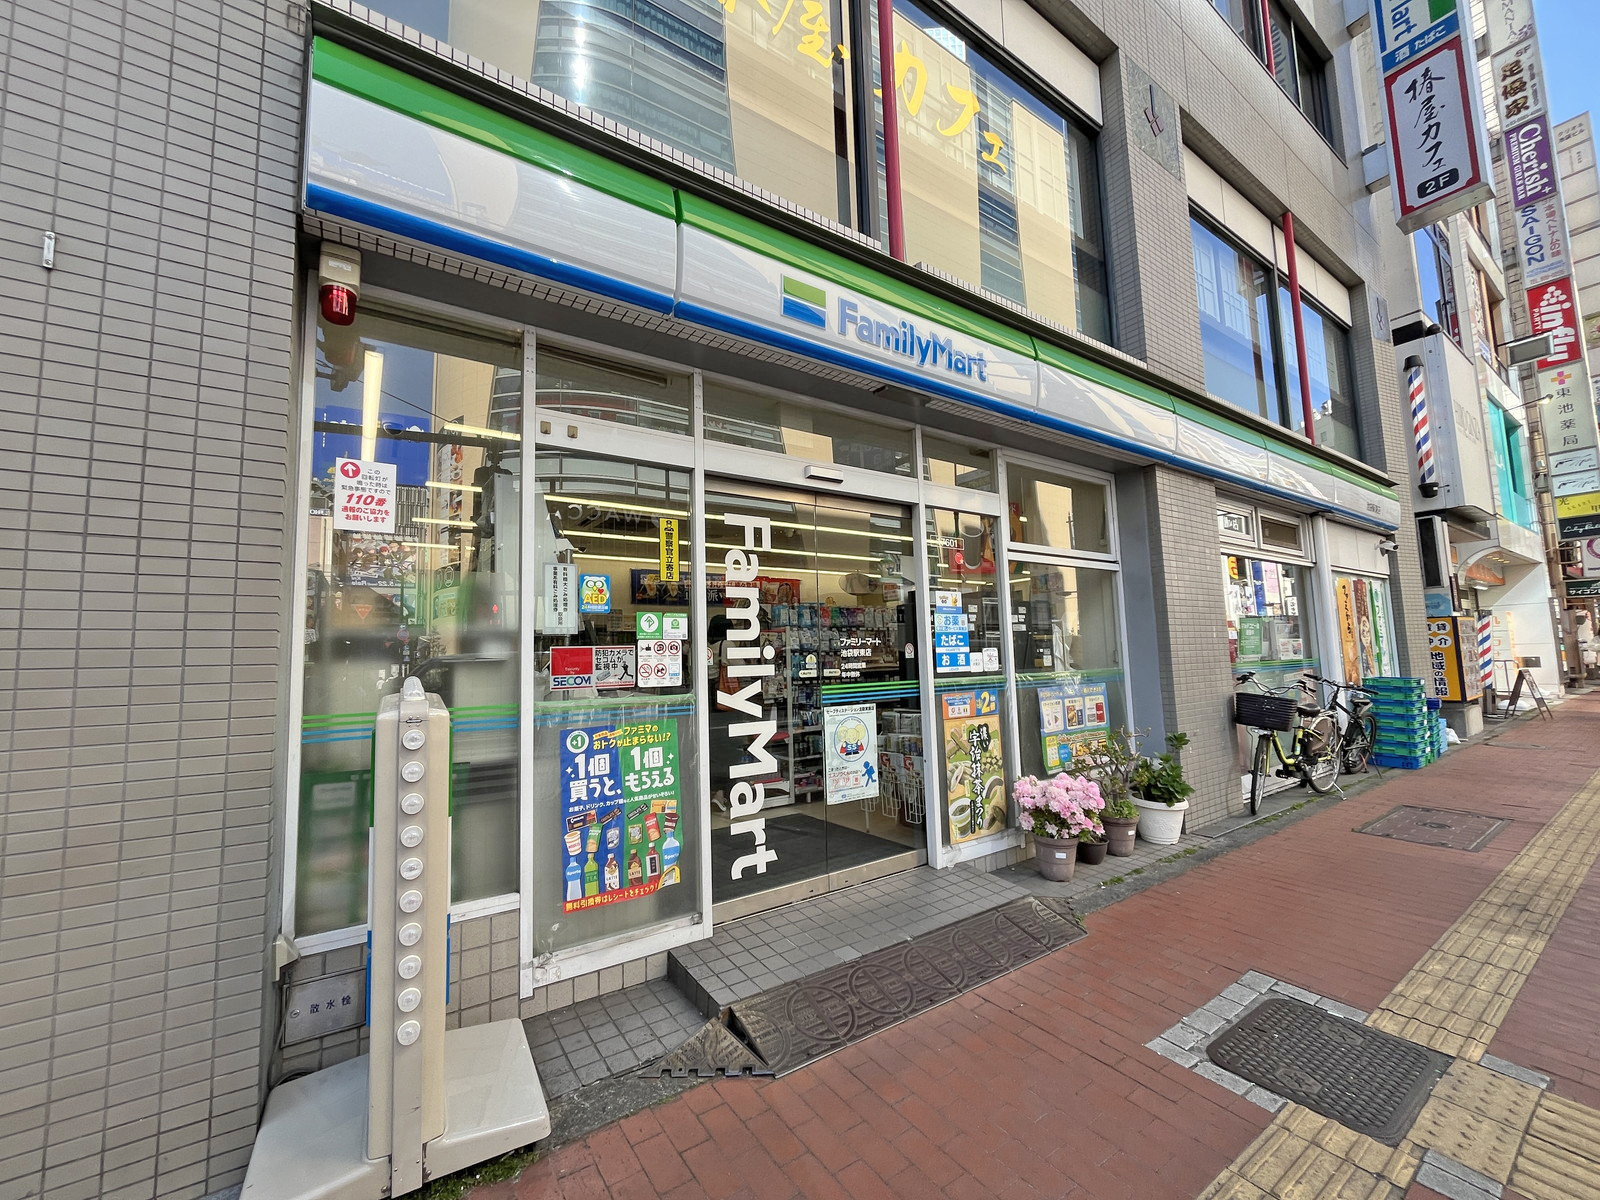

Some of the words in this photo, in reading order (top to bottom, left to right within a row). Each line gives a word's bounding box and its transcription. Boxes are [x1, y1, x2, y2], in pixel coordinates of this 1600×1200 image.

[1394, 45, 1410, 63] 酒
[1414, 25, 1447, 51] たばこ
[1404, 66, 1446, 172] 椿屋カフェ
[1425, 173, 1450, 195] 2F
[1532, 307, 1542, 330] PARTY
[837, 296, 988, 382] FamilyMart
[1555, 386, 1579, 447] 東池薬局
[341, 484, 392, 495] 緊急事態ですので
[346, 493, 388, 507] 110番
[341, 505, 390, 517] 通報のご協力を
[345, 513, 387, 523] お願いします
[583, 593, 607, 604] AED
[943, 615, 960, 626] お薬
[840, 638, 882, 646] ファミリーマート
[940, 634, 965, 646] たばこ
[595, 649, 634, 657] 防犯カメラで
[941, 653, 966, 666] お酒
[595, 663, 619, 671] 監視中
[1430, 651, 1449, 697] 地域の情報
[552, 675, 592, 687] SECOM
[716, 512, 779, 881] FamilyMart
[624, 724, 659, 737] ファミマの
[574, 753, 610, 779] 1個
[630, 746, 664, 771] 1個
[625, 766, 675, 793] もらえる
[968, 729, 985, 829] 宇治抹茶まつり
[569, 776, 622, 803] 買うと、
[309, 994, 352, 1014] 散水栓
